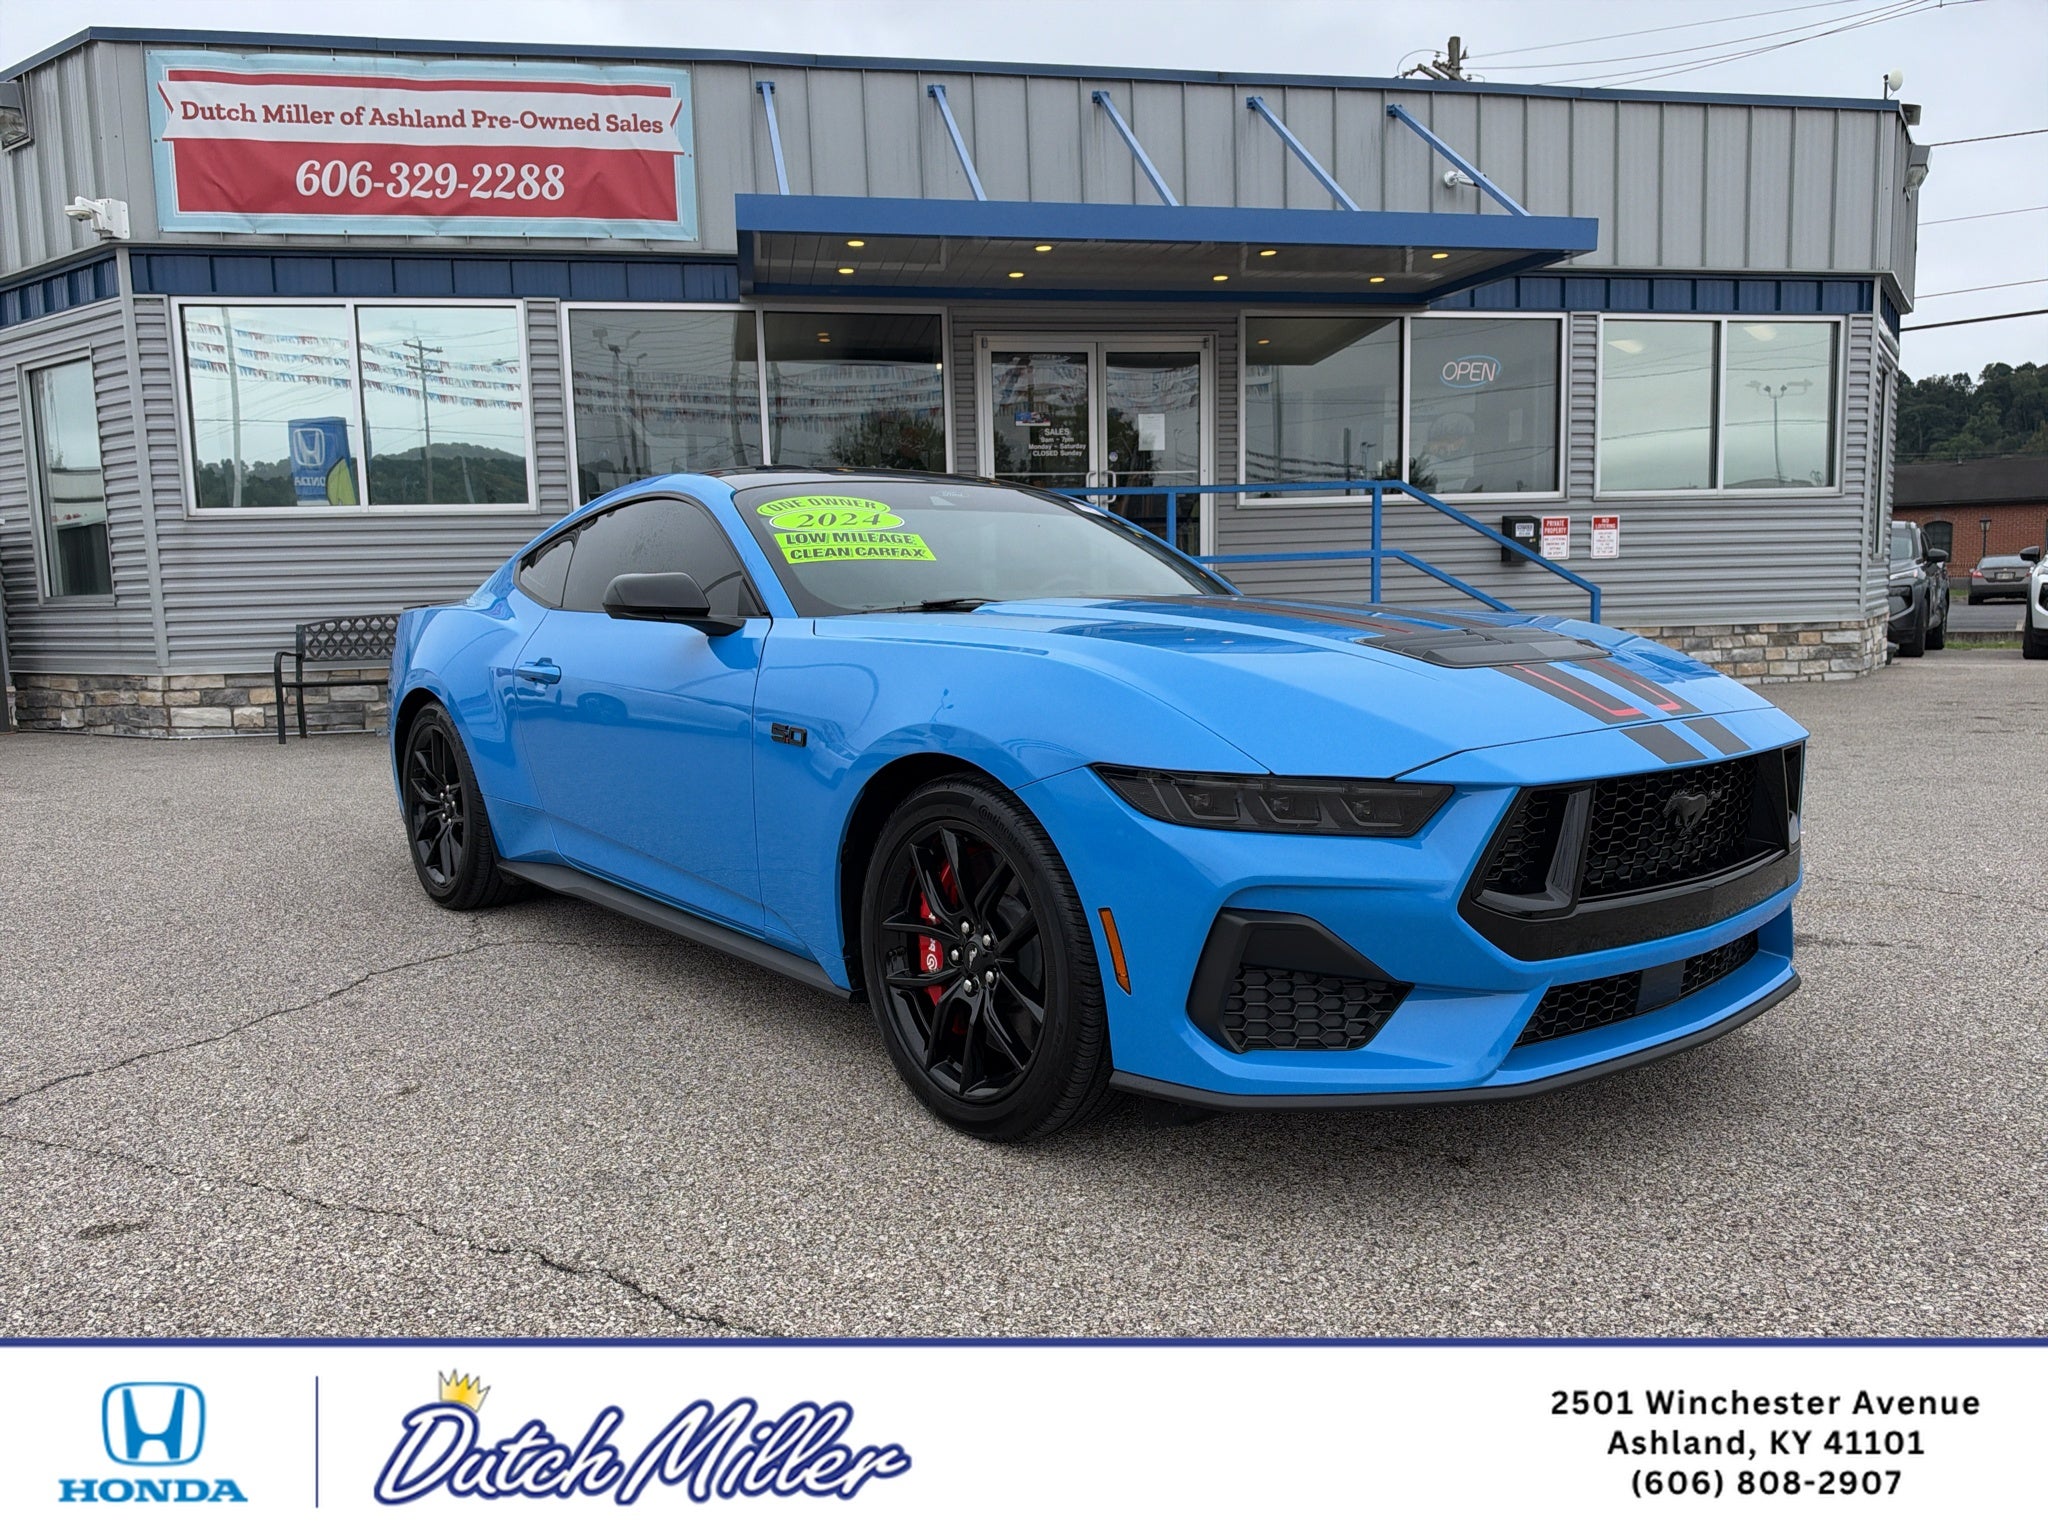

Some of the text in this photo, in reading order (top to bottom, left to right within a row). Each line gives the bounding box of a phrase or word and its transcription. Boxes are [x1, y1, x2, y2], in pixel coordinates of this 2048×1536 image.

[180, 101, 664, 134] Dutch Miller of Ashland Pre-Owned Sales
[295, 159, 565, 201] 606-329-2288
[1442, 361, 1497, 382] OPEN
[1044, 428, 1070, 436] SALES
[766, 497, 876, 512] ONE OWNER
[796, 512, 881, 529] 2024
[1546, 519, 1565, 527] PRIVATE
[785, 532, 916, 545] LOW MILEAGE
[790, 547, 925, 560] CLEAN CARFAX
